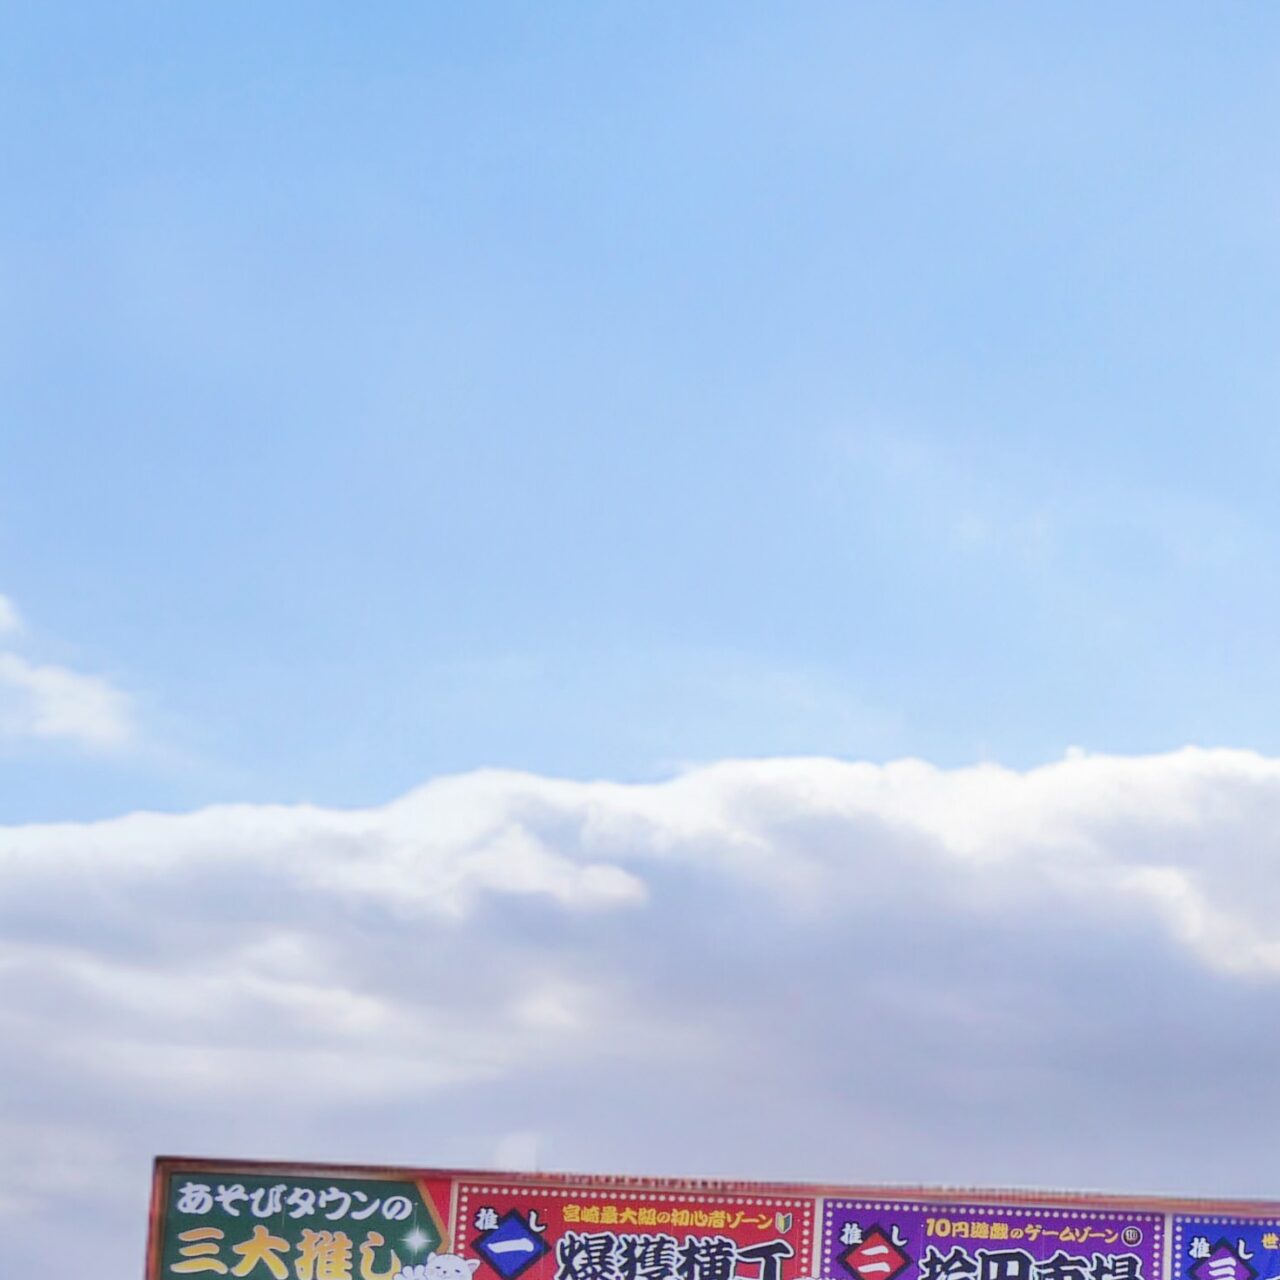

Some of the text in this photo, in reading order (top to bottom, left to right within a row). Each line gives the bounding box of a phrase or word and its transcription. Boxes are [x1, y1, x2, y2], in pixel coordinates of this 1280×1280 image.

[177, 1181, 413, 1221] あそびタウンの
